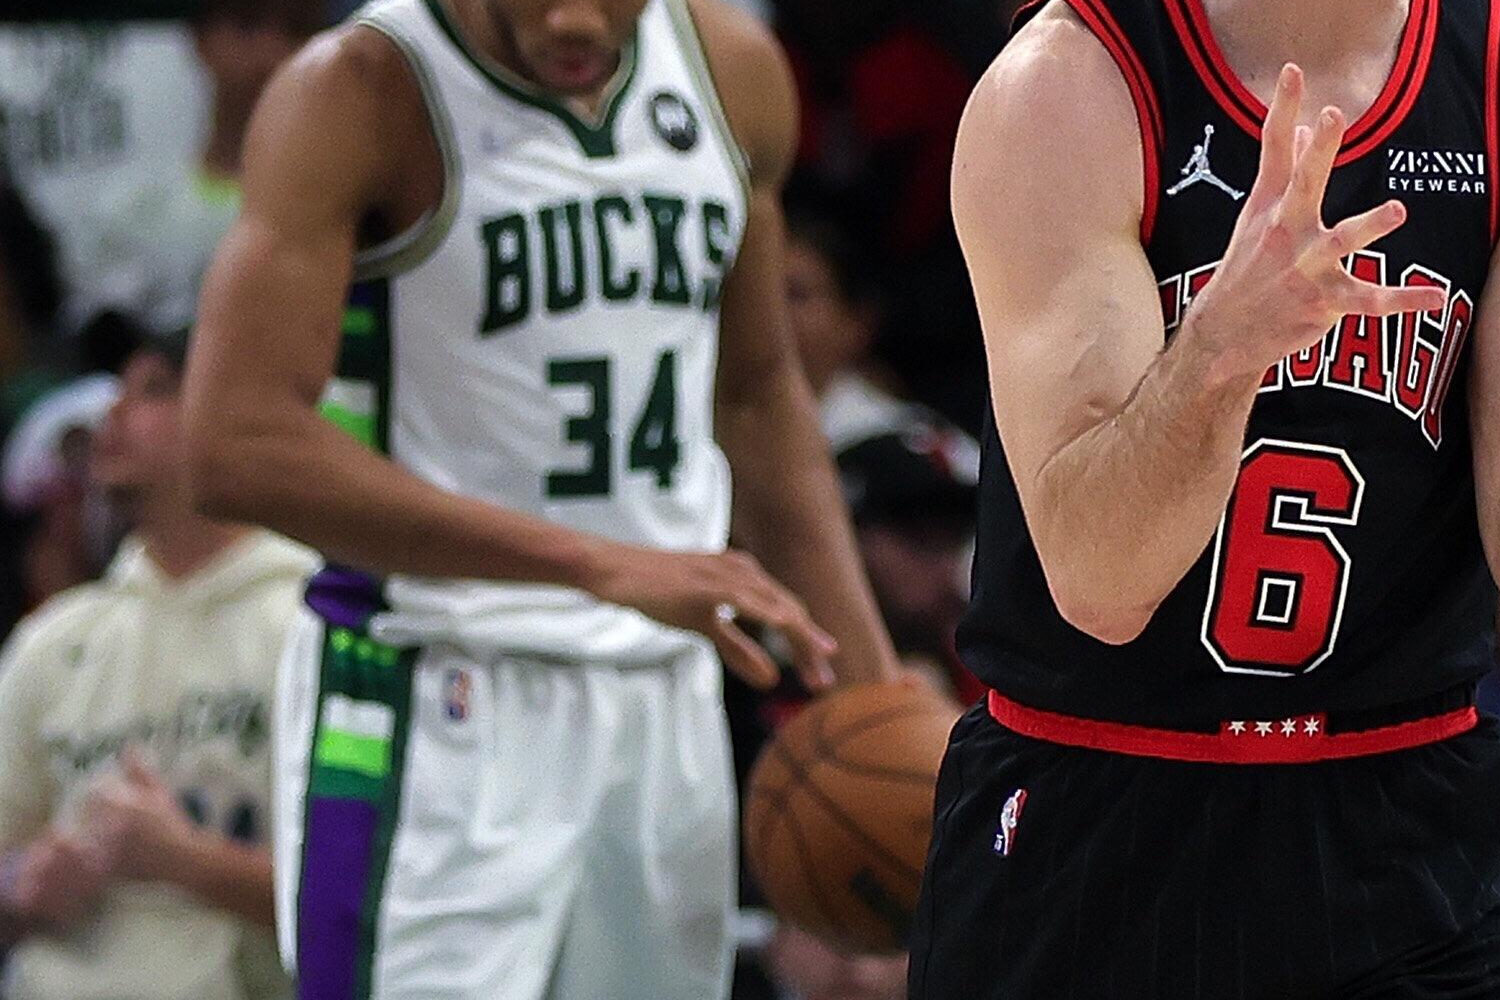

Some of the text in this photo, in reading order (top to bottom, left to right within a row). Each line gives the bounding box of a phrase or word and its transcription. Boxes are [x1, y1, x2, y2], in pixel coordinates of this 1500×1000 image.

[1388, 149, 1485, 175] ZENNI
[1388, 177, 1486, 194] EYEWEAR
[480, 190, 730, 338] BUCKS
[546, 348, 679, 497] 34
[1201, 437, 1366, 677] 6
